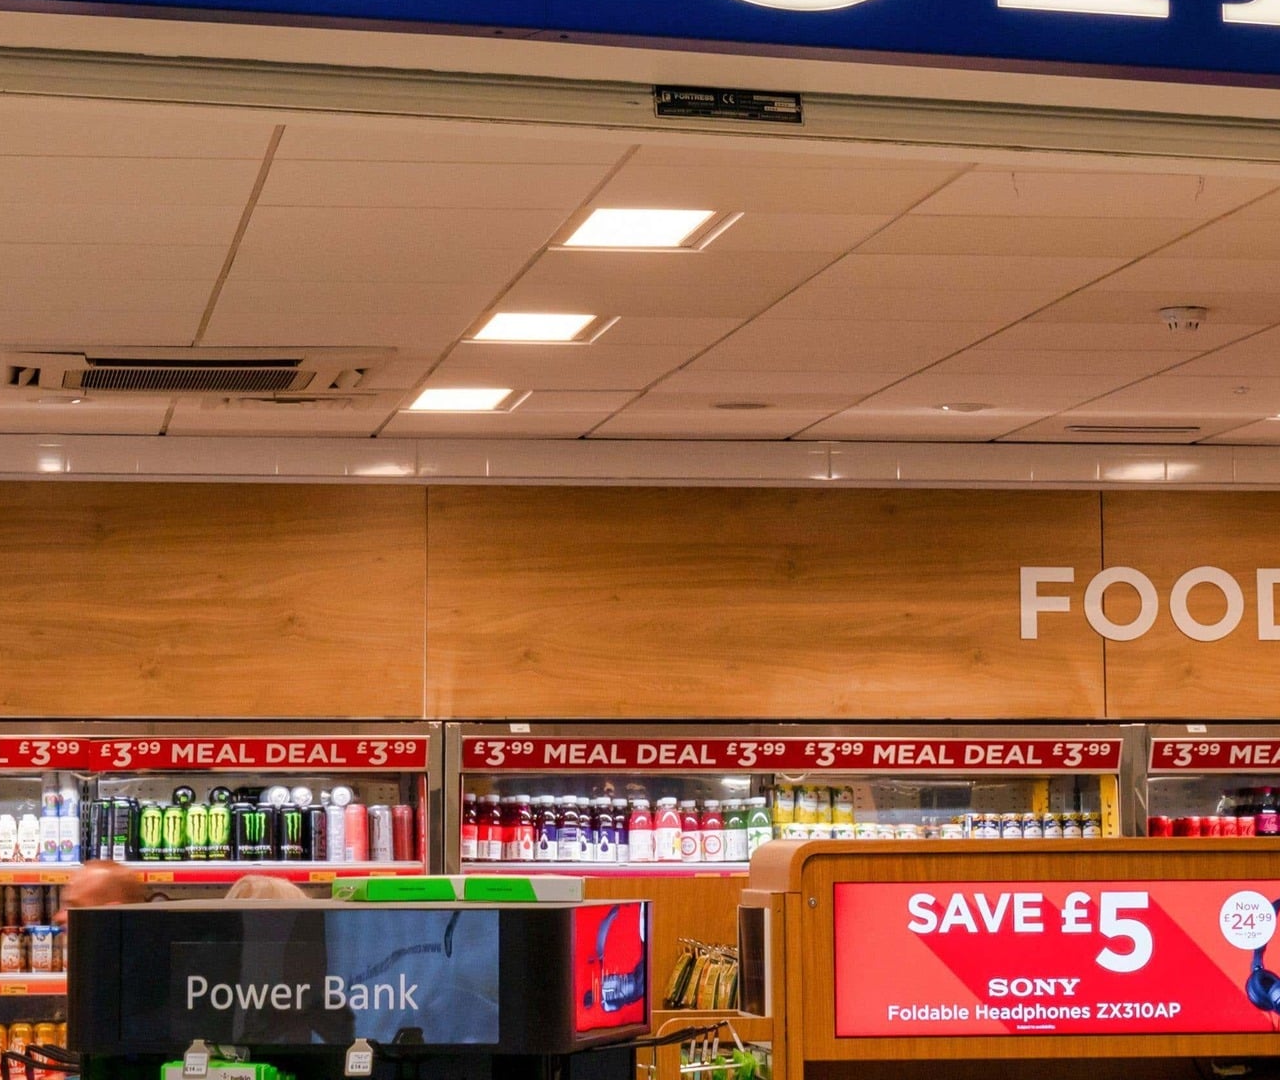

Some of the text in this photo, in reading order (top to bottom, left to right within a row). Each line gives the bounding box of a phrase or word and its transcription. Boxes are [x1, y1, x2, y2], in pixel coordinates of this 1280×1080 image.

[171, 743, 255, 764] MEAL
[265, 743, 347, 763] DEAL
[543, 743, 627, 764] MEAL
[636, 744, 717, 765] DEAL
[872, 744, 955, 765] MEAL
[964, 744, 1043, 765] DEAL
[1235, 902, 1260, 911] Now
[907, 891, 1153, 973] SAVE £5
[188, 973, 419, 1010] Power Bank
[988, 977, 1081, 997] SONY
[887, 1003, 1182, 1022] Foldable Headphones ZX310AP
